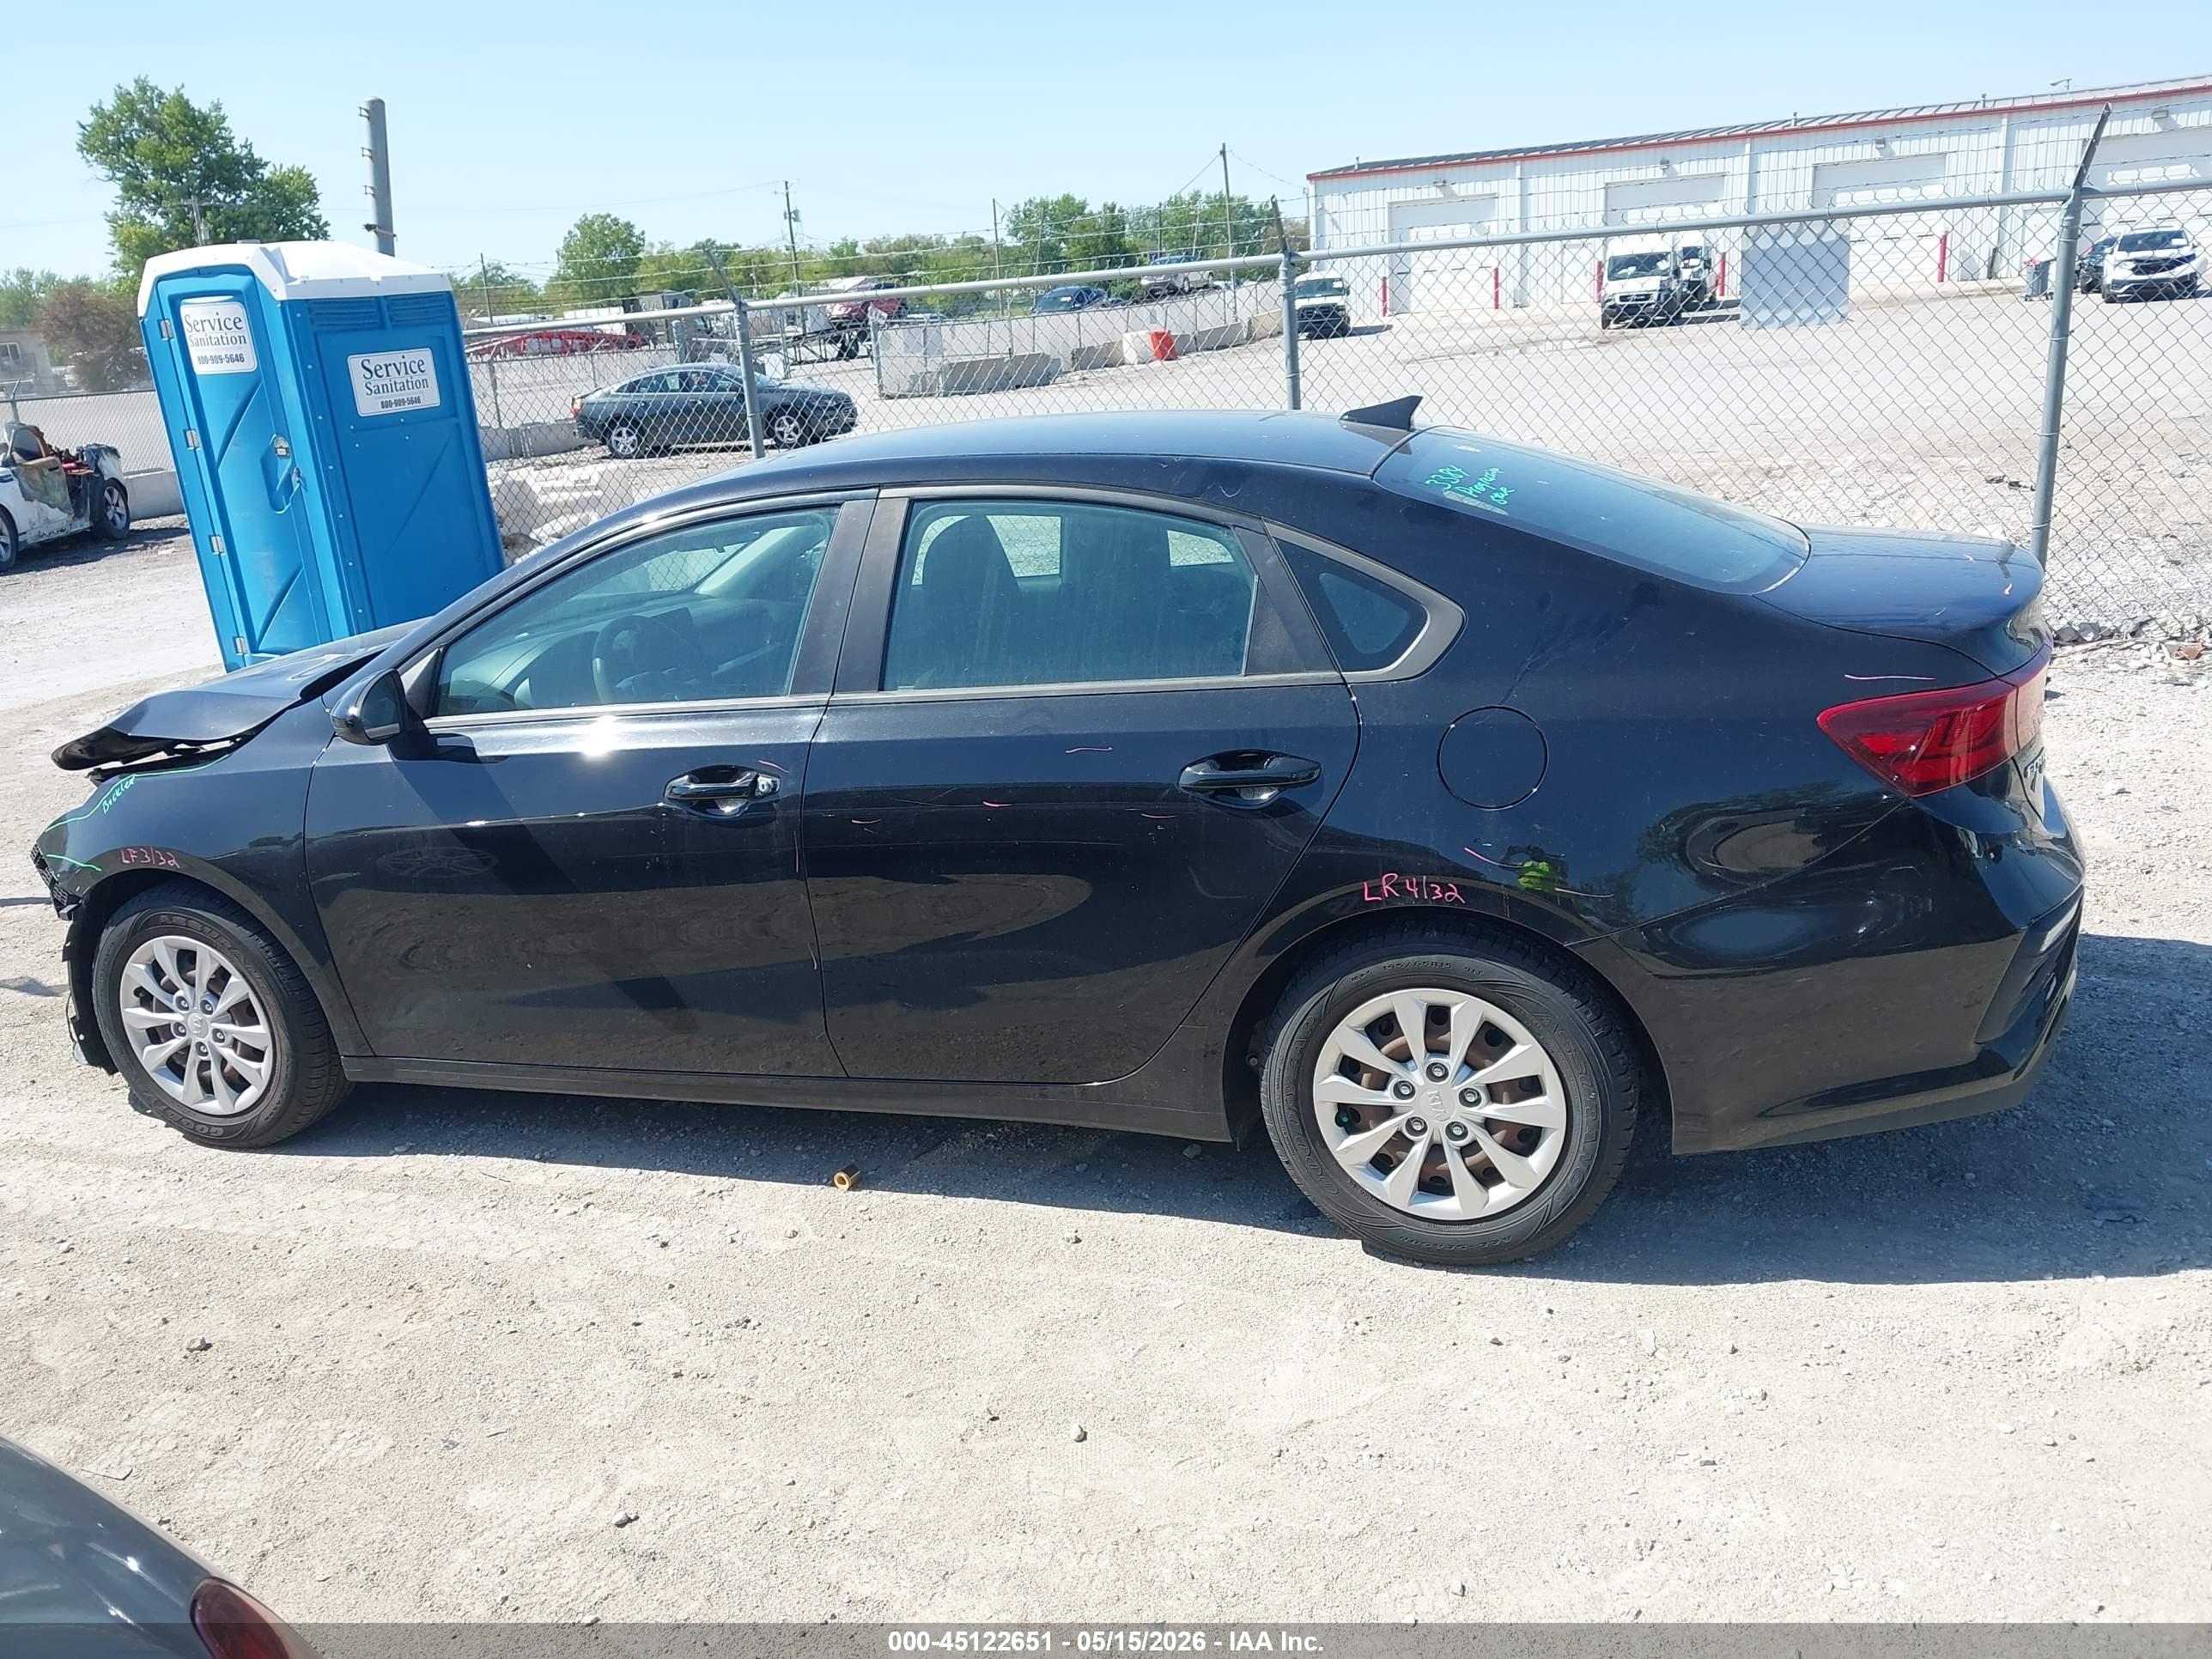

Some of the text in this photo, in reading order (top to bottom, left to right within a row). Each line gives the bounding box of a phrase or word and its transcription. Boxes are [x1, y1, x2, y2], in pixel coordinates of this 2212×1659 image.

[184, 312, 244, 333] Service
[188, 332, 247, 348] Sanitation
[197, 353, 245, 365] 800-909-5646
[361, 355, 426, 380] Service
[364, 377, 429, 396] Sanitation
[380, 396, 422, 410] 800-909-5646
